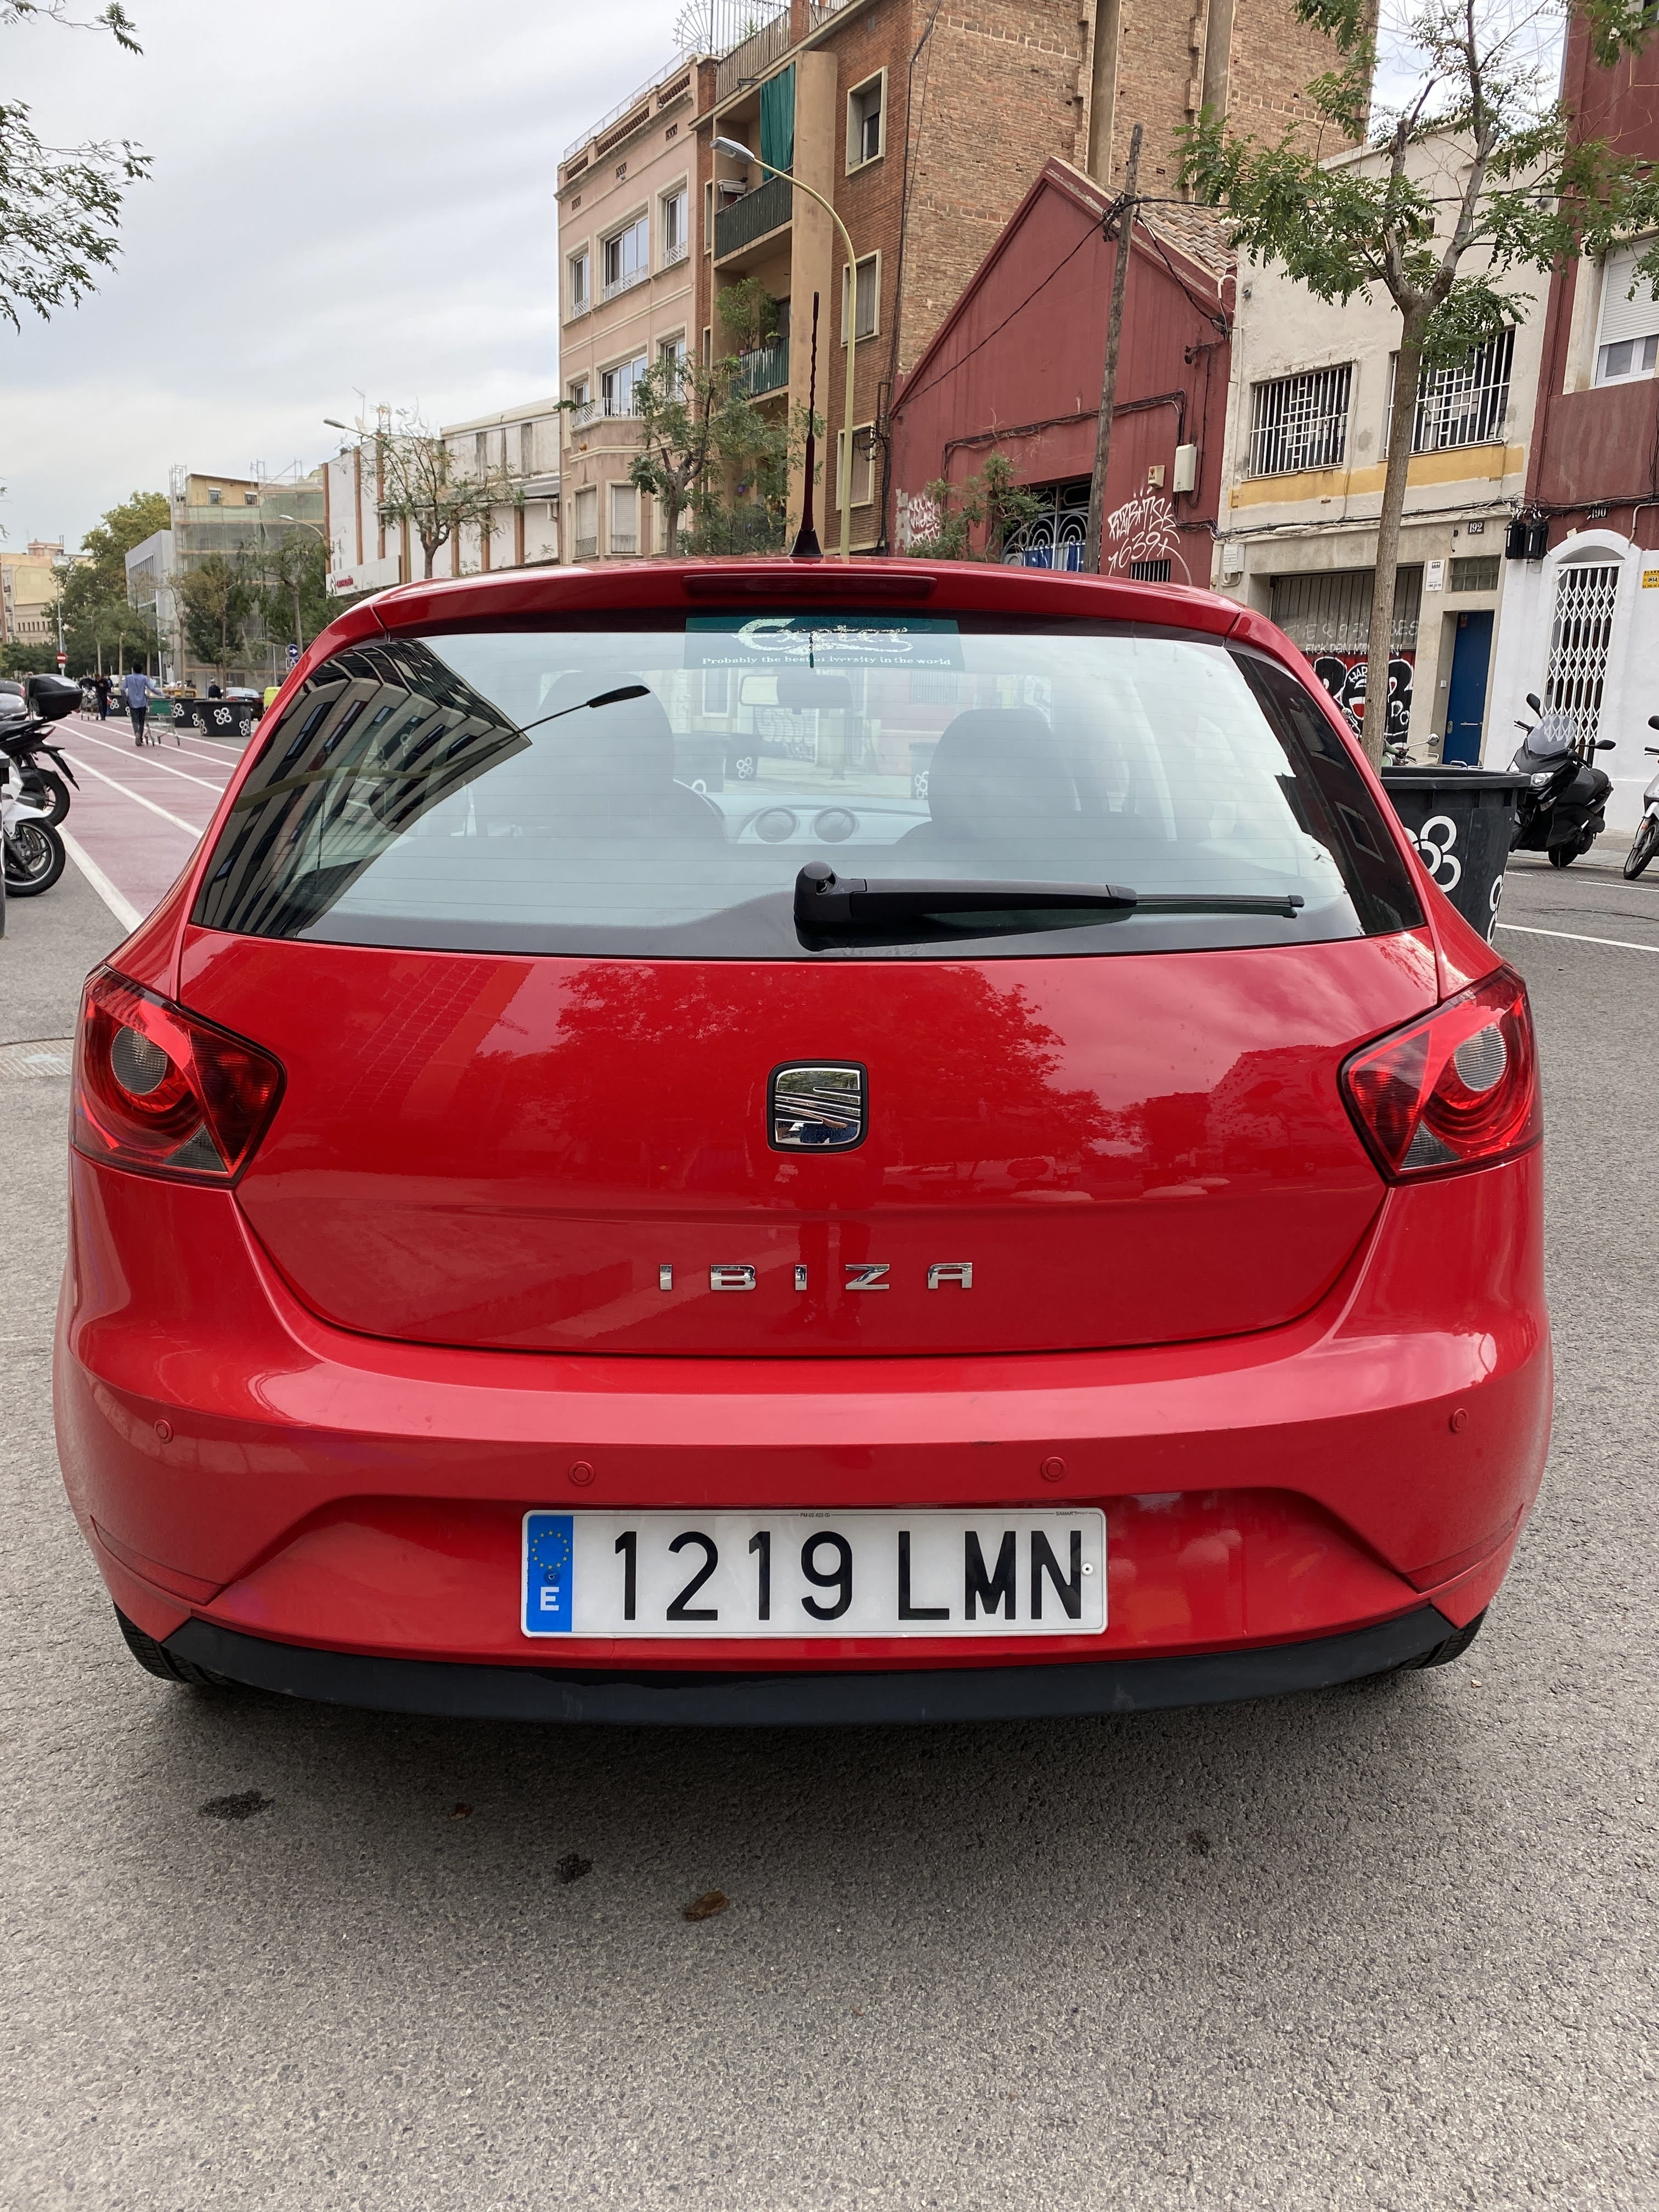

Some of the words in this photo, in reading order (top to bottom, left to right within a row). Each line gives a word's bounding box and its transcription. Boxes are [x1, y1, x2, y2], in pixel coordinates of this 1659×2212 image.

[1469, 522, 1483, 533] 192
[660, 1262, 973, 1291] IBIZA
[615, 1531, 853, 1621] 1219
[898, 1531, 1081, 1620] LMN
[540, 1586, 560, 1611] E
